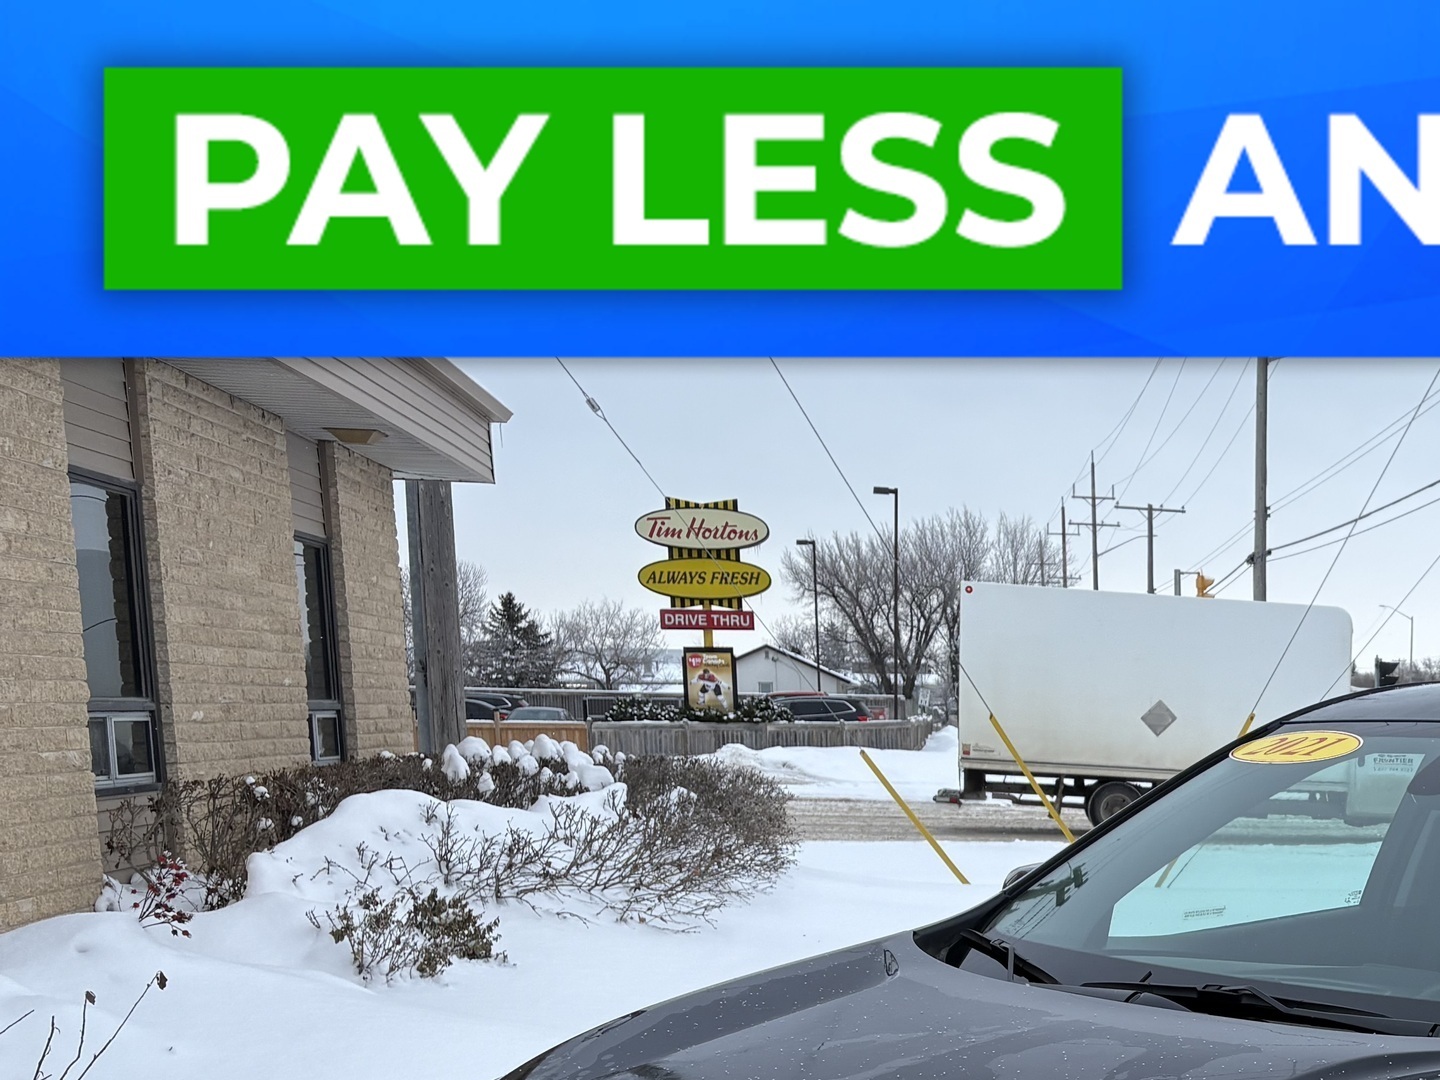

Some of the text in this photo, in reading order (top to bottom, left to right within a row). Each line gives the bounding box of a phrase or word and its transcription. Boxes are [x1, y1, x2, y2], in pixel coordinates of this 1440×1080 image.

[646, 516, 759, 541] Tim Hortons
[646, 570, 761, 585] ALWAYS FRESH
[664, 613, 750, 627] DRIVE THRU
[1241, 736, 1350, 756] 2021
